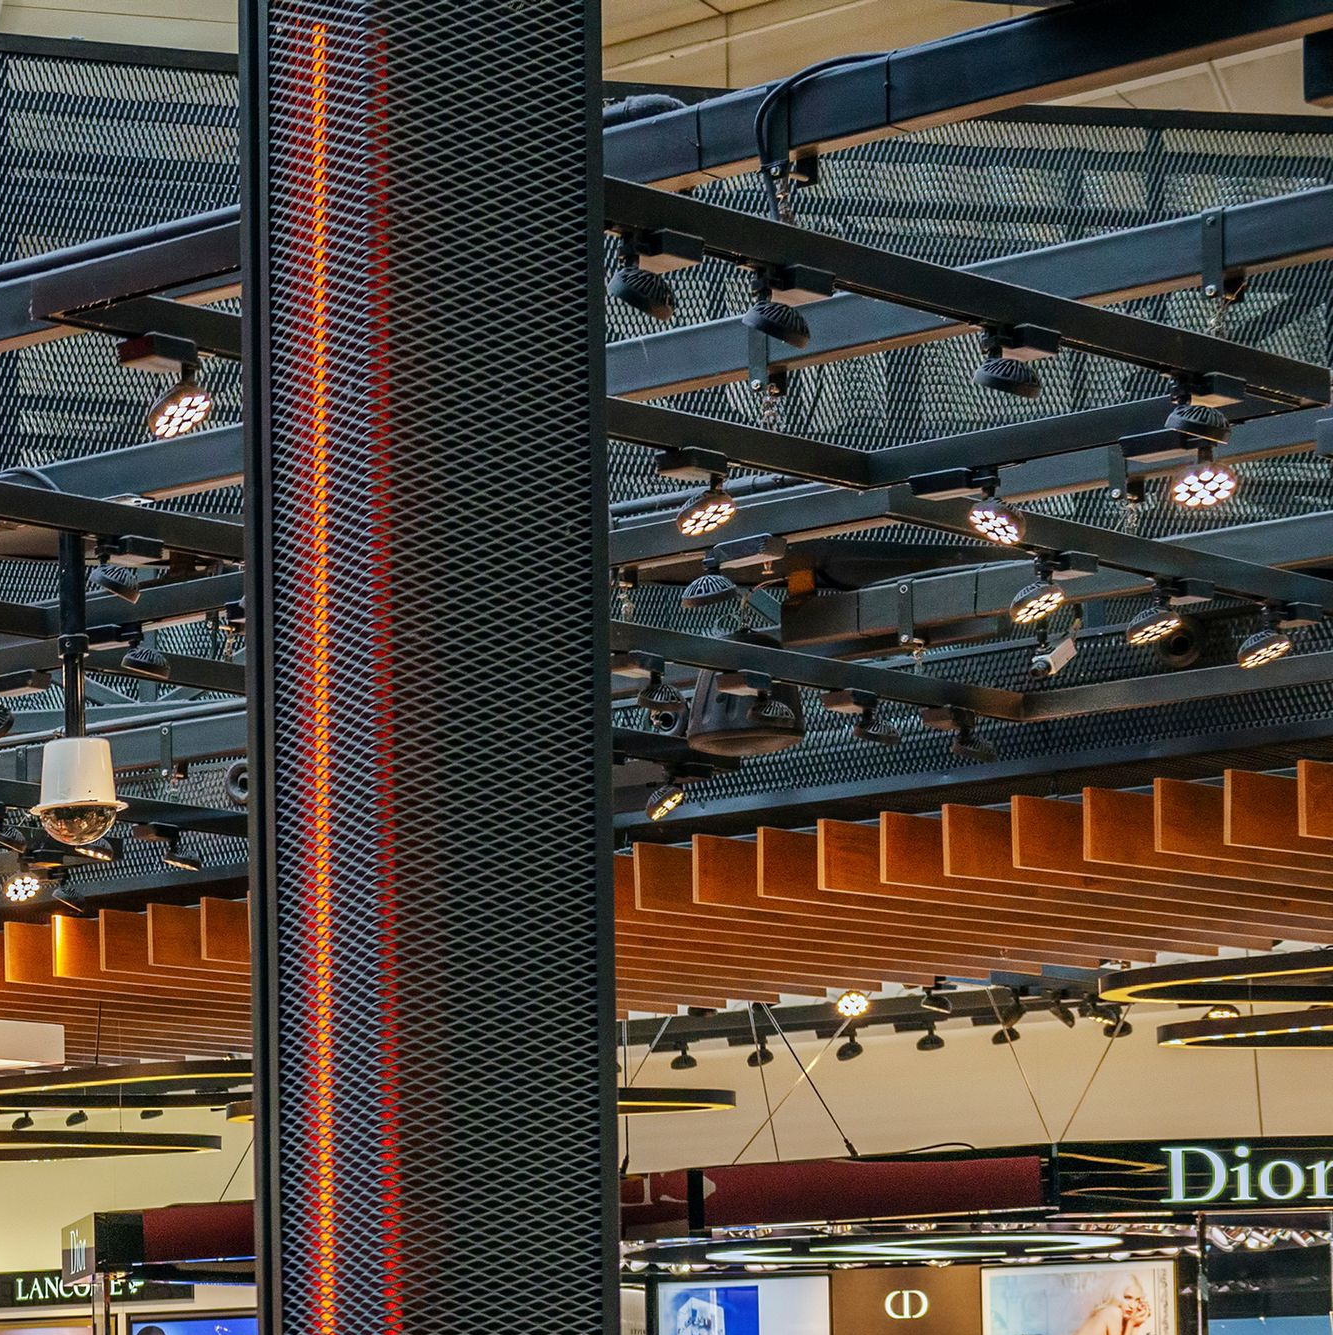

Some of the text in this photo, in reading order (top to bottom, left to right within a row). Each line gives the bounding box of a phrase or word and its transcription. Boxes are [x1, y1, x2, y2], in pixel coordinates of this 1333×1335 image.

[1161, 1146, 1333, 1204] Dior
[69, 1230, 87, 1275] Dior
[16, 1277, 123, 1302] LANCE
